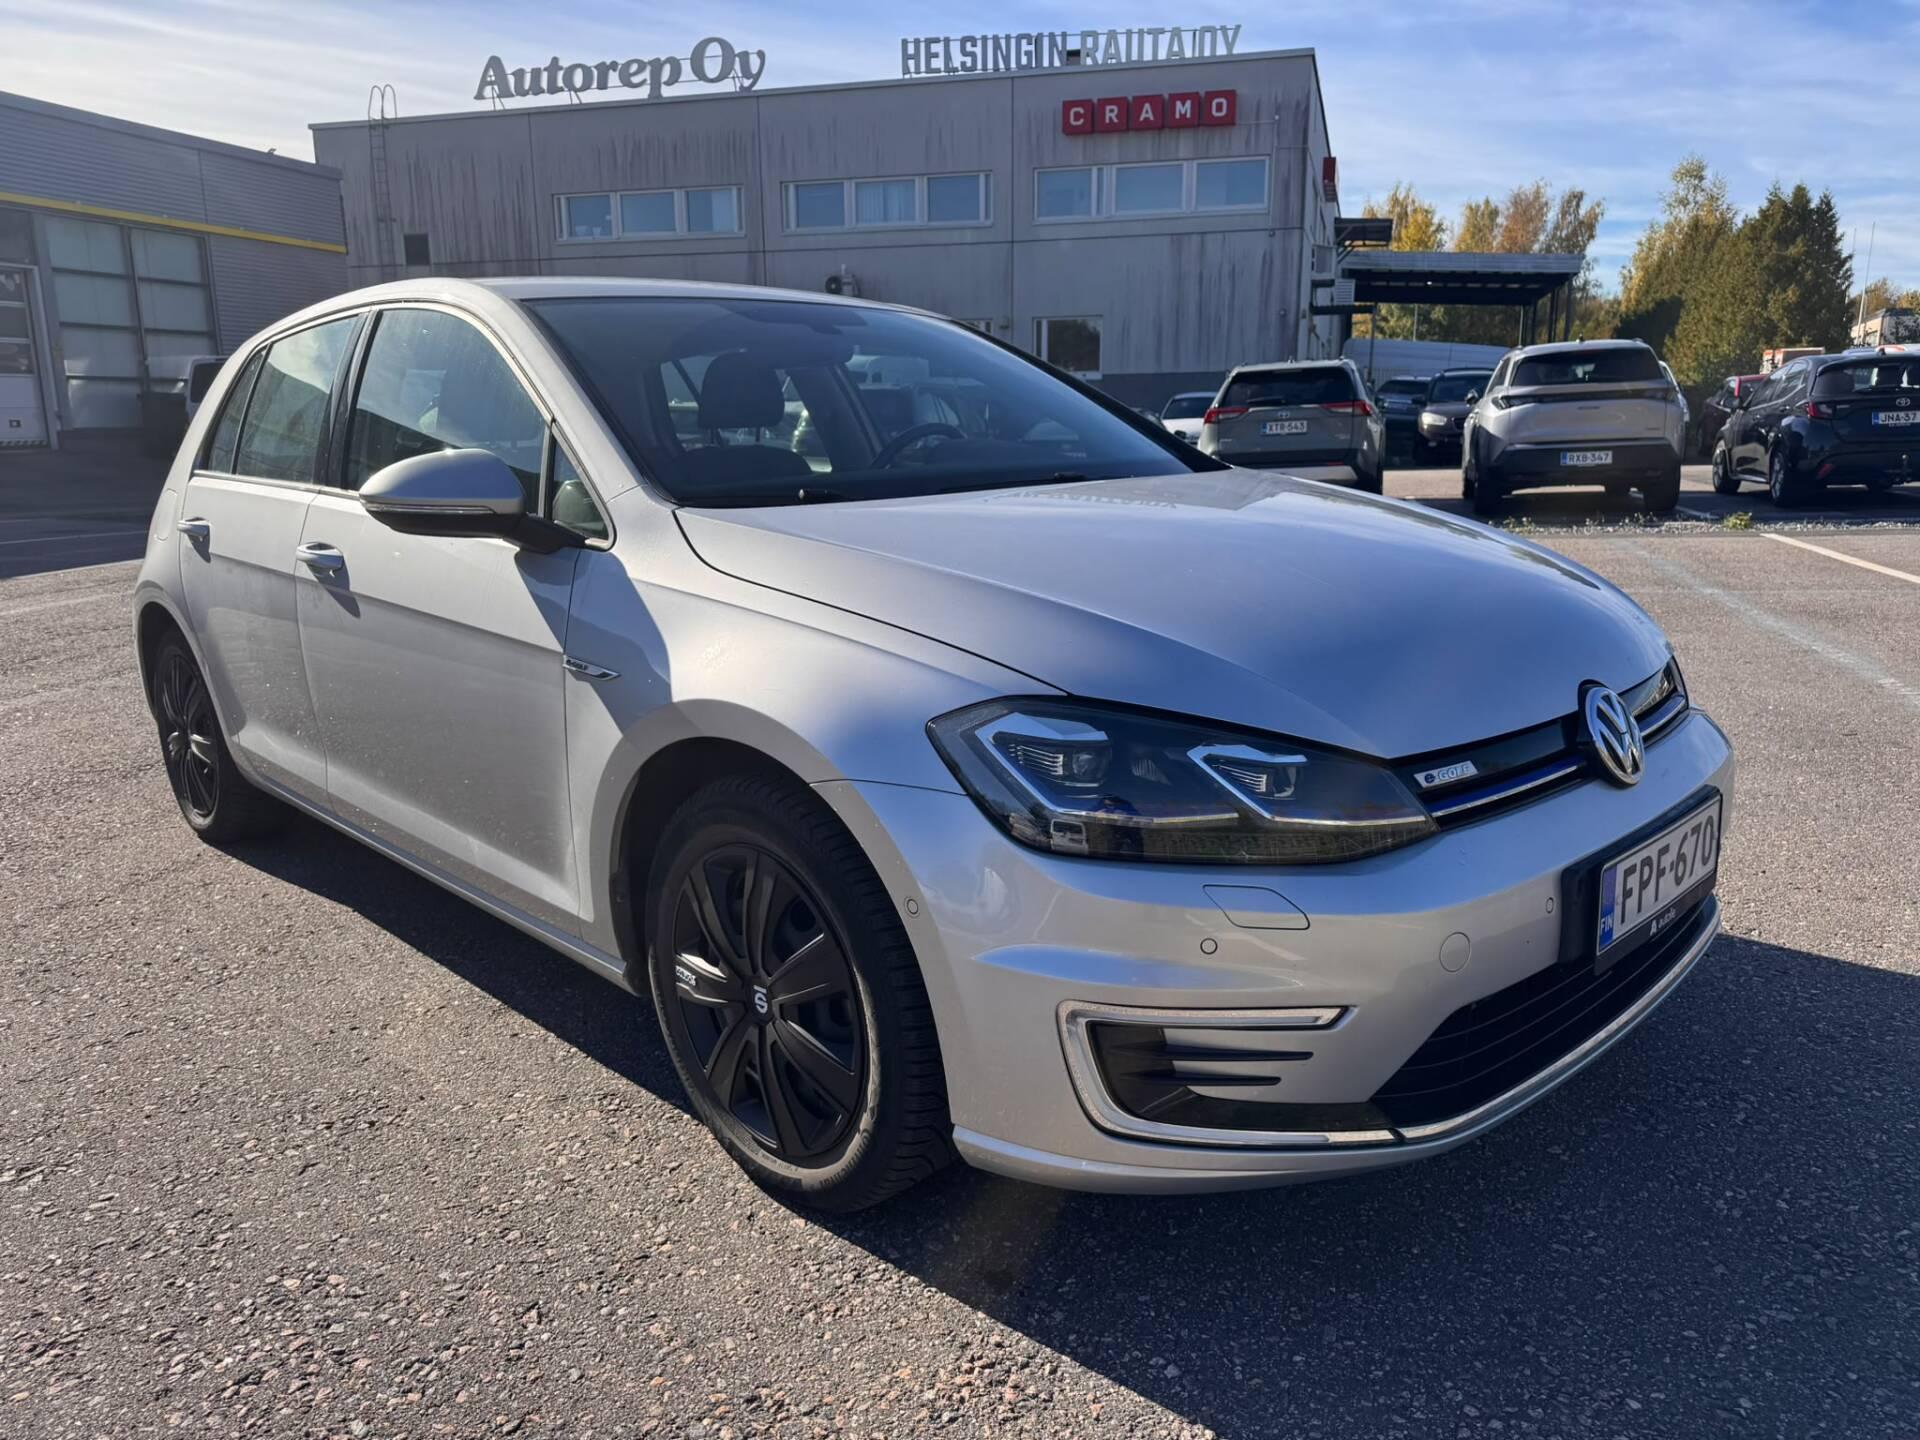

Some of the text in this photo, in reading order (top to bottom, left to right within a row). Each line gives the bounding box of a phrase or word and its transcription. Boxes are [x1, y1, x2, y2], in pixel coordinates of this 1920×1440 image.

[473, 37, 766, 99] Autorep Oy
[901, 31, 1067, 75] HELSINGIN
[1080, 27, 1186, 66] RAUTA
[1069, 98, 1227, 127] CRAMO
[1620, 815, 1714, 925] FPF-670
[1600, 916, 1614, 934] FIN
